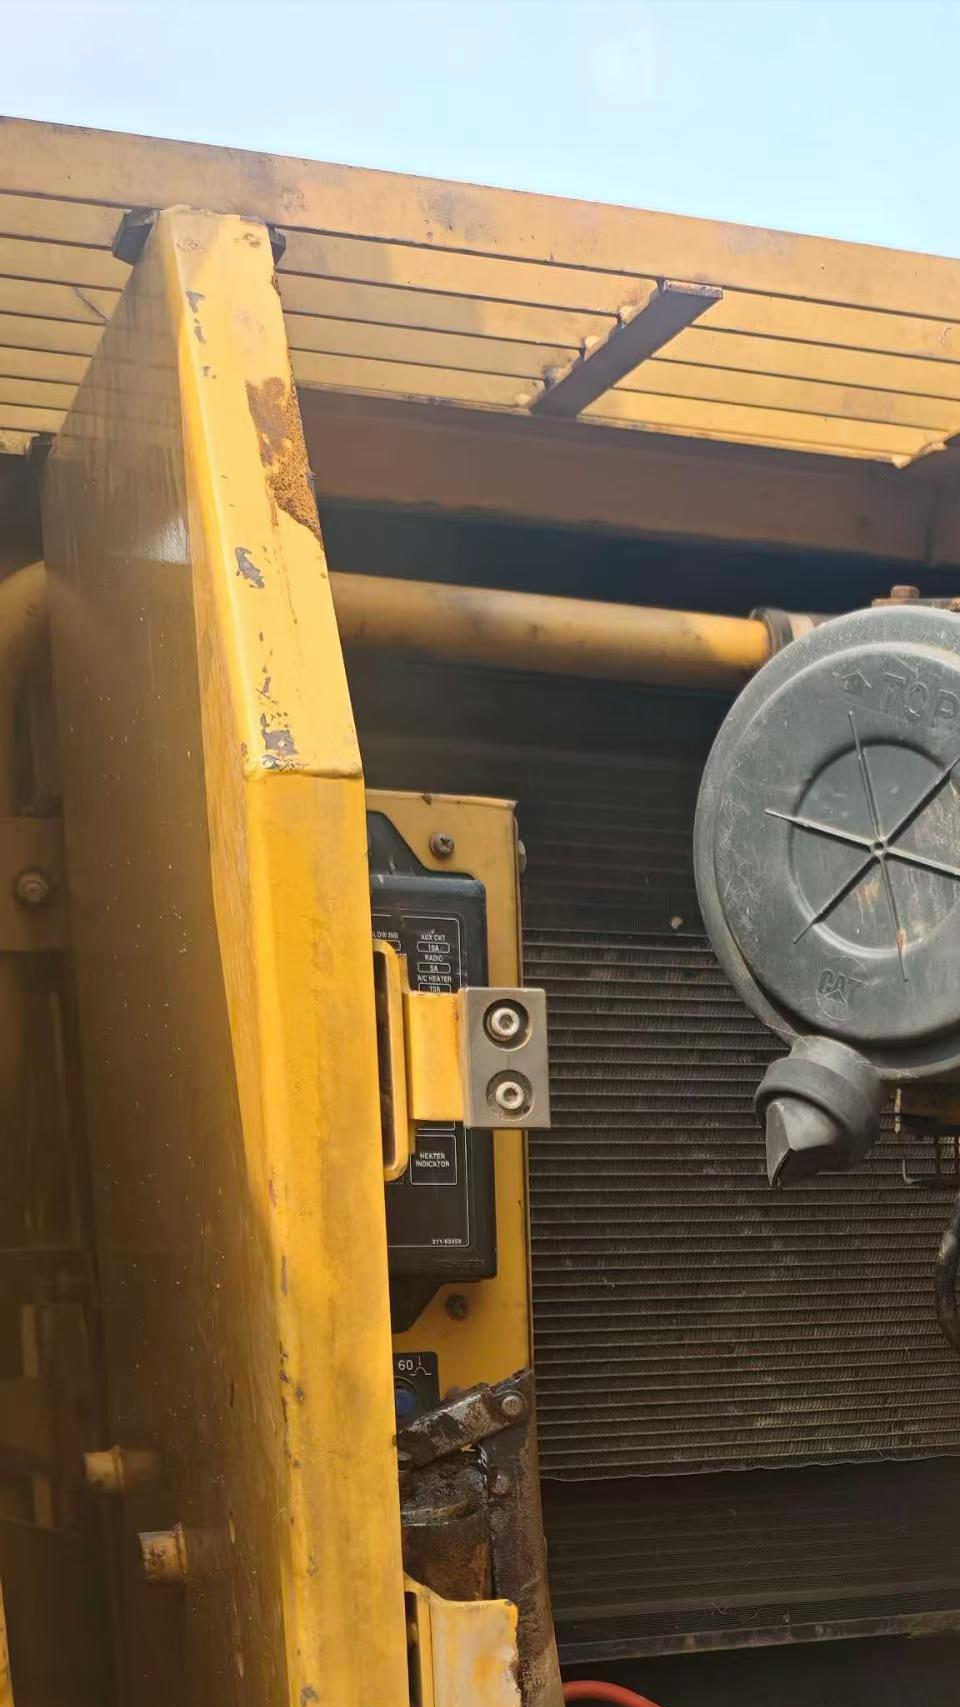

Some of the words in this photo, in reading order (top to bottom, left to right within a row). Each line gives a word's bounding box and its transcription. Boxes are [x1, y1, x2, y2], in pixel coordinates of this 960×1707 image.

[882, 671, 960, 732] TOP
[424, 954, 443, 962] RADIO
[430, 964, 439, 973] 5A
[819, 968, 869, 1011] CAT
[415, 1160, 450, 1168] INDICATOR
[398, 1359, 413, 1371] 60
